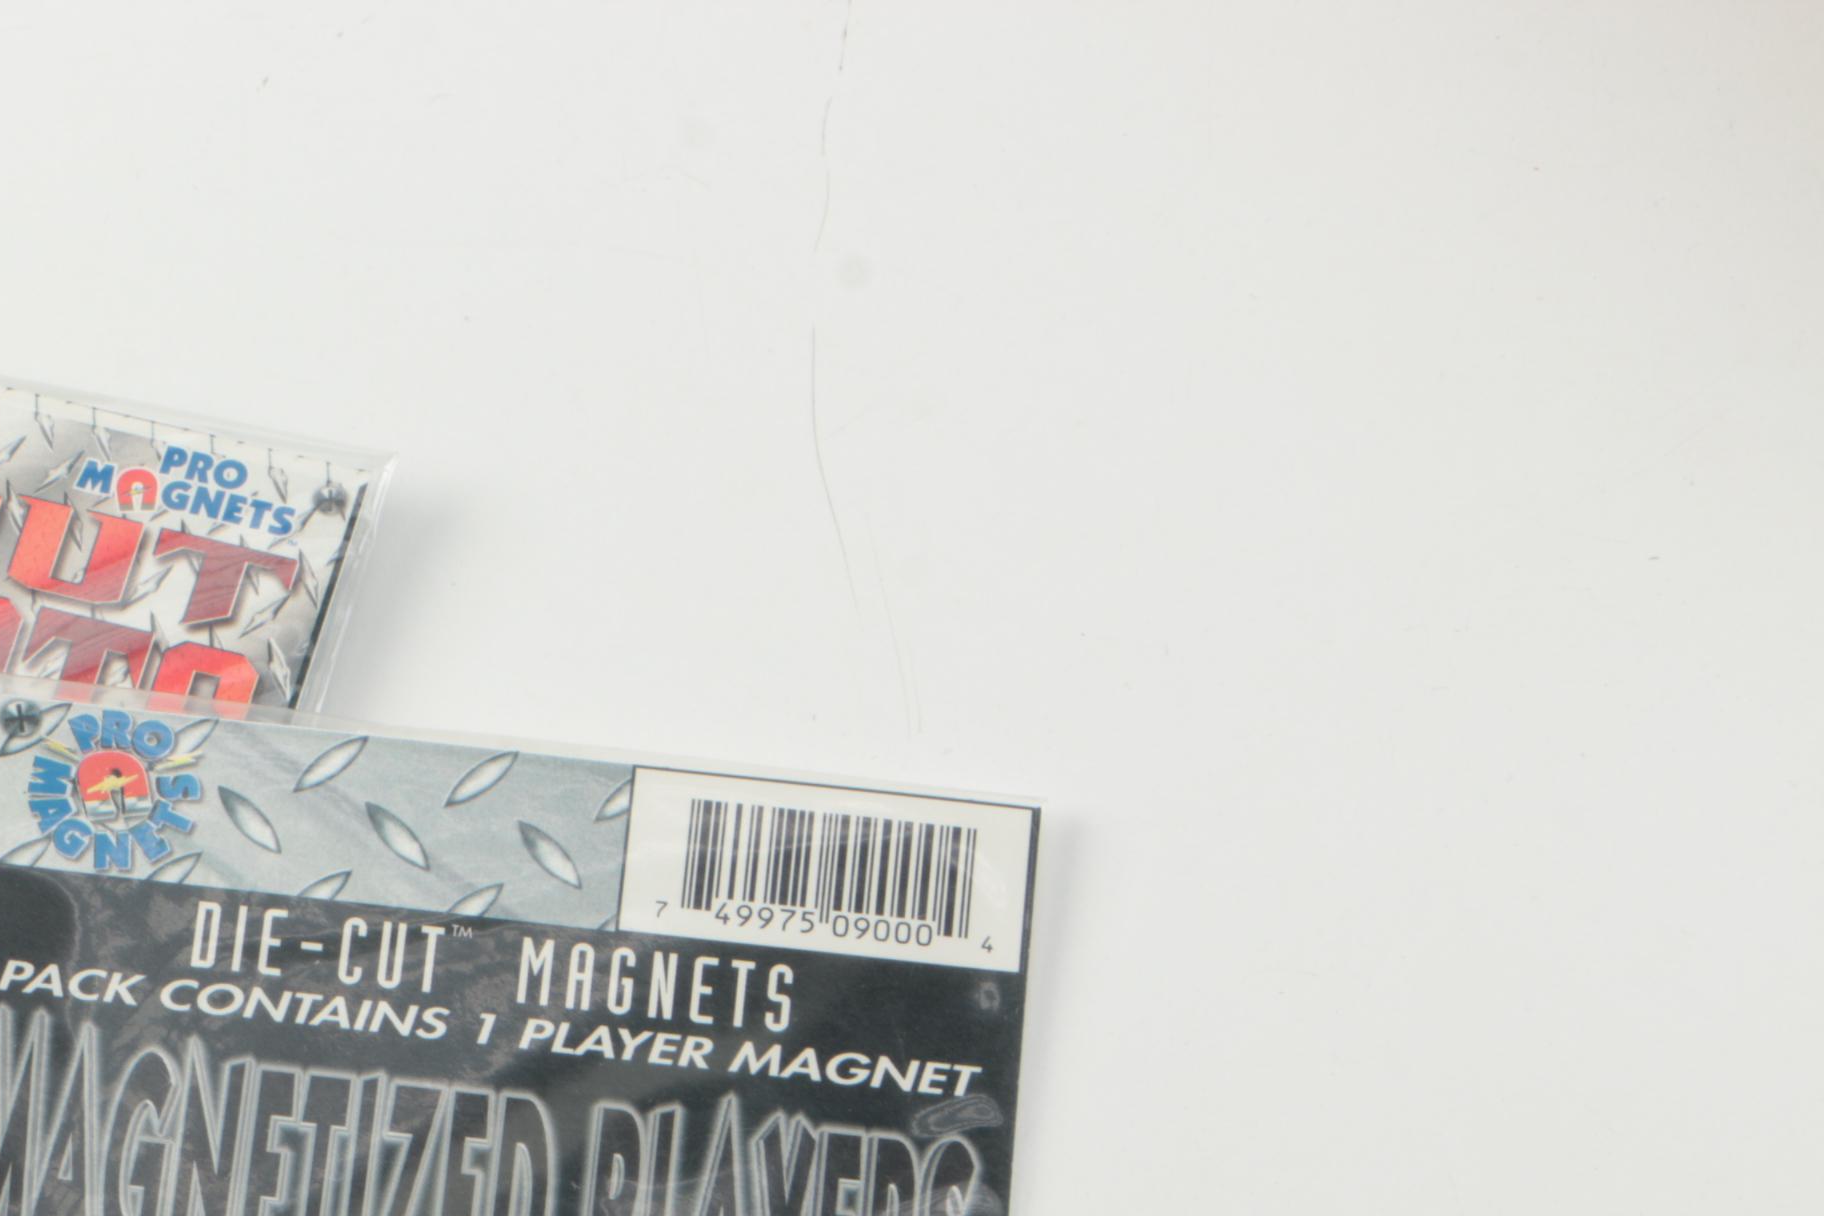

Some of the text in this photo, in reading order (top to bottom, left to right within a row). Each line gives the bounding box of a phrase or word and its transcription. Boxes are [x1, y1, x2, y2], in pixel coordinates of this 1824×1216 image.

[161, 445, 249, 491] PRO
[68, 710, 176, 758] PRO
[654, 900, 995, 954] 7 49975 09000 4
[516, 936, 795, 1033] MAGNETS
[159, 979, 451, 1041] CONTAINS
[476, 1012, 496, 1046] 1
[518, 1018, 715, 1070] PLAYER
[728, 1041, 982, 1098] MAGNET
